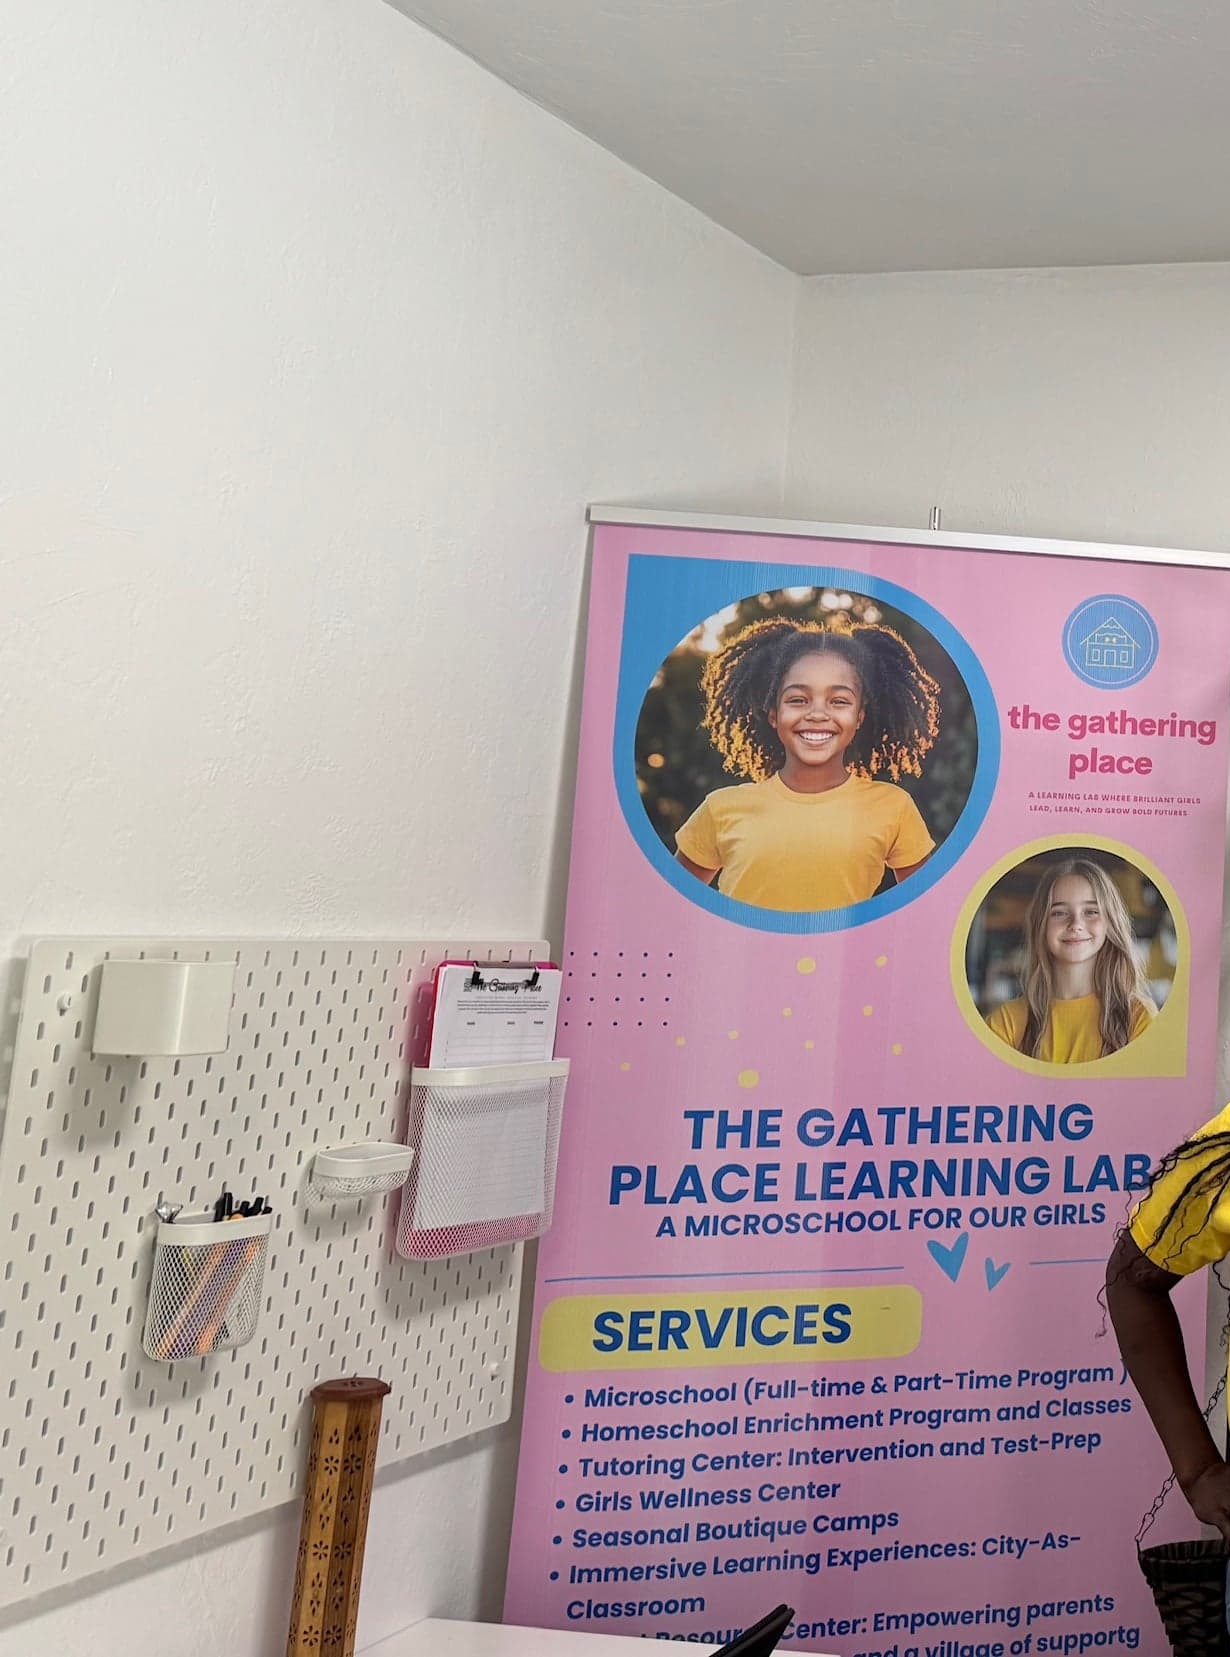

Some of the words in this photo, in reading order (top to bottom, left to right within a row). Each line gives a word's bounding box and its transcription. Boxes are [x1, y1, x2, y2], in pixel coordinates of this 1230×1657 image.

[1007, 704, 1061, 731] the
[1067, 709, 1217, 746] gathering
[1068, 747, 1153, 780] place
[1037, 791, 1081, 800] LEARNING
[1083, 793, 1099, 801] LAB
[1101, 793, 1131, 802] WHERE
[1133, 795, 1175, 804] BRILLIANT
[1085, 806, 1103, 814] AND
[1105, 807, 1130, 815] GROW
[1154, 808, 1188, 817] FUTURES
[683, 1108, 783, 1150] THE
[796, 1102, 1094, 1148] GATHERING
[609, 1161, 781, 1206] PLACE
[794, 1155, 1050, 1201] LEARNING
[1063, 1152, 1152, 1193] LAB
[656, 1214, 677, 1238] A
[684, 1209, 901, 1238] MICROSCHOOL
[908, 1206, 962, 1230] FOR
[969, 1205, 1027, 1229] OUR
[1033, 1201, 1106, 1226] GIRLS
[592, 1303, 852, 1353] SERVICES
[584, 1382, 737, 1408] Microschool
[743, 1377, 866, 1406] (Full-time
[871, 1374, 888, 1394] &
[894, 1371, 1013, 1393] Part-Time
[581, 1415, 738, 1442] Homeschool
[744, 1409, 884, 1435] Enrichment
[889, 1405, 991, 1430] Program
[996, 1401, 1041, 1422] and
[1045, 1397, 1132, 1419] Classes
[579, 1455, 686, 1481] Tutoring
[691, 1449, 782, 1472] Center:
[788, 1441, 934, 1466] Intervention
[939, 1438, 985, 1457] and
[992, 1430, 1102, 1455] Test-Prep
[575, 1492, 632, 1513] Girls
[639, 1486, 752, 1511] Wellness
[758, 1481, 841, 1503] Center
[573, 1522, 690, 1549] Seasonal
[695, 1518, 808, 1542] Boutique
[812, 1511, 899, 1536] Camps
[569, 1560, 707, 1584] Immersive
[712, 1552, 821, 1576] Learning
[826, 1540, 976, 1570] Experiences:
[982, 1533, 1081, 1558] City-As-
[566, 1596, 706, 1621] Classroom
[873, 1606, 1021, 1633] Empowering
[1026, 1595, 1115, 1624] parents
[1009, 1633, 1033, 1656] of
[1036, 1625, 1141, 1656] supportg
